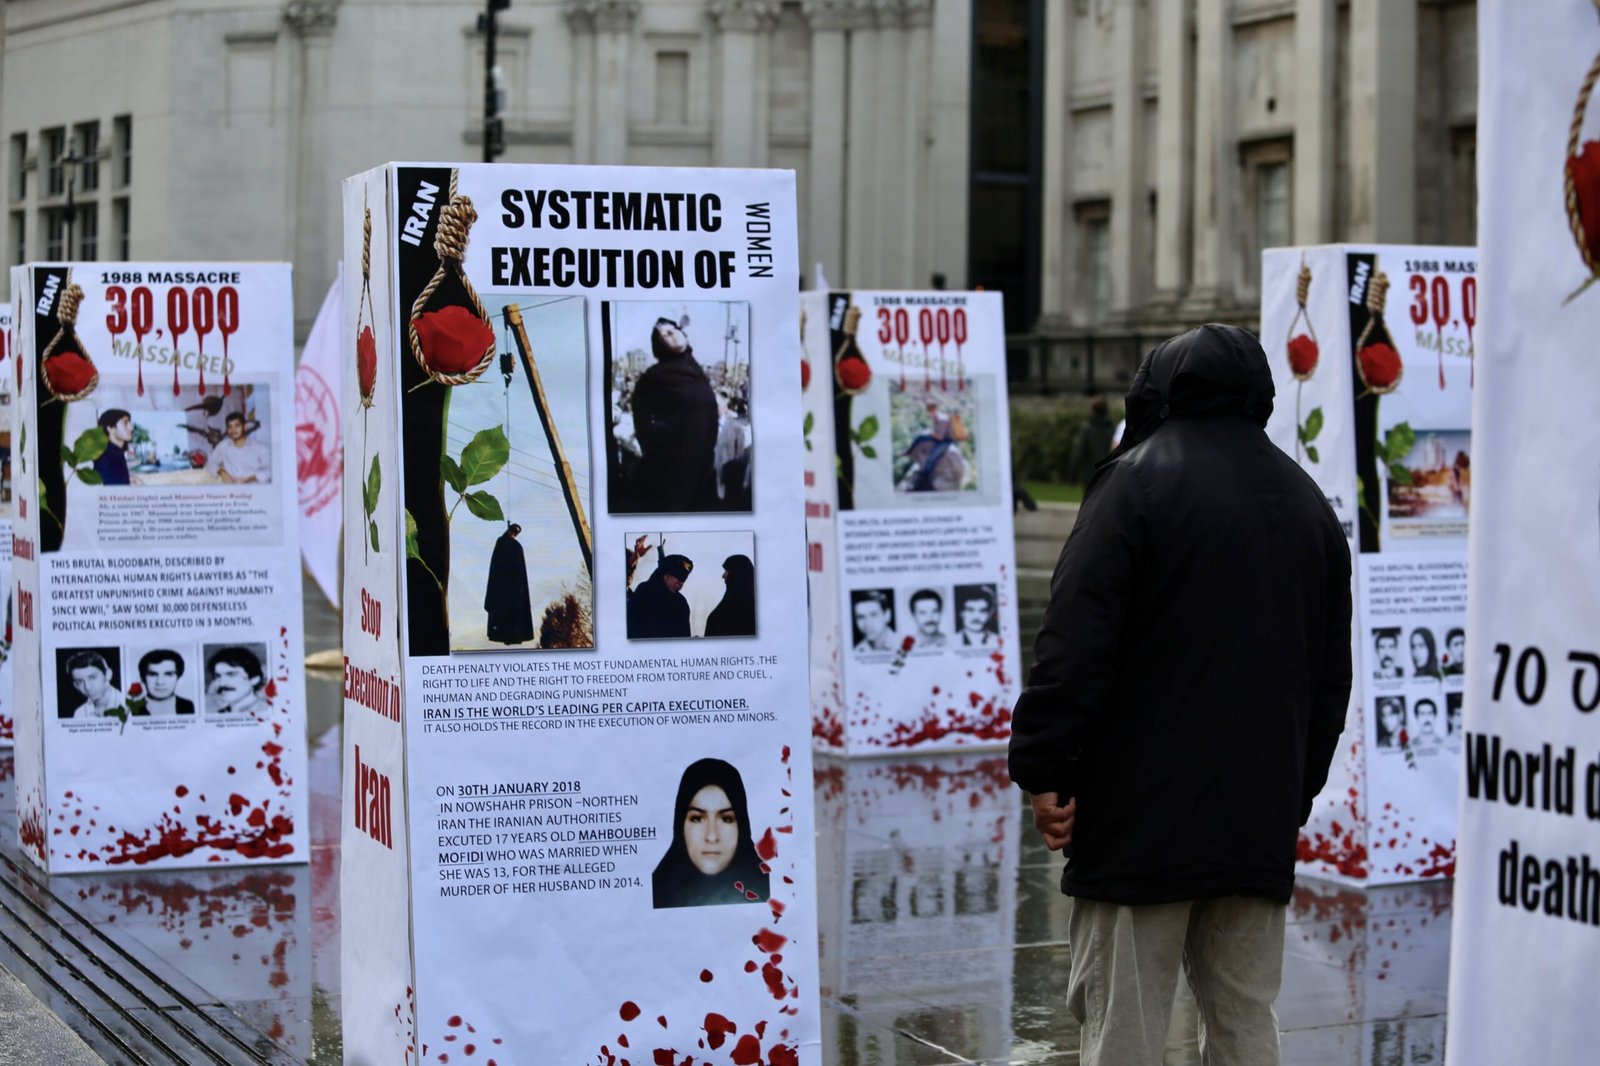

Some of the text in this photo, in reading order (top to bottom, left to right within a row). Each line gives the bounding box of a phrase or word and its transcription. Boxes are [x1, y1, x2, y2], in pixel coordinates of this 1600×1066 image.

[400, 181, 440, 246] IRAN
[501, 189, 722, 232] SYSTEMATIC
[745, 202, 773, 278] WOMEN
[491, 247, 736, 289] EXECUTION OF
[1405, 261, 1439, 272] 1988
[101, 272, 241, 284] 1988 MASSACRE
[1350, 260, 1370, 305] IRAN
[37, 274, 61, 317] IRAN
[105, 286, 239, 340] 30,000
[112, 339, 235, 375] MASSACRED
[51, 559, 70, 569] THIS
[72, 558, 106, 568] BRUTAL
[107, 557, 163, 569] BLOODBATH,
[214, 556, 226, 566] BY
[51, 573, 121, 585] INTERNATIONAL
[123, 572, 158, 583] HUMAN
[160, 572, 192, 582] RIGHTS
[193, 571, 234, 581] LAWYERS
[235, 570, 247, 580] AS
[51, 585, 274, 600] GREATEST UNPUNISHED CRIME AGAINST HUMANITY
[52, 606, 76, 616] SINCE
[112, 604, 132, 614] SAW
[134, 604, 159, 614] SOME
[162, 603, 189, 615] 30,000
[190, 602, 247, 612] DEFENSELESS
[361, 587, 381, 641] Stop
[52, 617, 255, 632] POLITICAL PRISONERS EXECUTED IN 3 MONTHS.
[422, 664, 456, 675] DEATH
[458, 663, 501, 674] PENALTY
[503, 662, 550, 672] VIOLATES
[551, 661, 571, 671] THE
[573, 660, 601, 670] MOST
[604, 658, 678, 670] FUNDAMENTAL
[681, 657, 718, 668] HUMAN
[720, 656, 755, 666] RIGHTS
[344, 656, 400, 723] Execution in
[422, 678, 454, 689] RIGHT
[455, 678, 469, 688] TO
[470, 677, 490, 688] LIFE
[492, 677, 515, 687] AND
[516, 676, 536, 686] THE
[539, 675, 570, 686] RIGHT
[571, 675, 584, 685] TO
[586, 673, 634, 684] FREEDOM
[636, 673, 666, 683] FROM
[667, 671, 710, 682] TORTURE
[712, 671, 735, 681] AND
[423, 688, 628, 703] INHUMAN AND DEGRADING PUNISHMENT
[424, 708, 450, 719] IRAN
[454, 708, 464, 718] IS
[466, 707, 489, 718] THE
[548, 703, 599, 715] LEADING
[602, 702, 623, 713] PER
[626, 701, 666, 712] CAPITA
[669, 698, 750, 711] EXECUTIONER.
[424, 712, 778, 733] IT ALSO HOLDS THE RECORD IN THE EXECUTION OF WOMEN AND MINORS.
[1466, 732, 1575, 817] World
[354, 744, 392, 850] Iran
[436, 781, 581, 796] ON 30TH JANUARY 2018
[440, 802, 453, 813] IN
[455, 799, 526, 813] NOWSHAHR
[528, 797, 573, 810] PRISON
[437, 812, 622, 830] IRAN THE IRANIAN AUTHORITIES
[438, 827, 657, 847] EXCUTED 17 YEARS OLD MAHBOUBEH
[438, 844, 638, 864] MOFIDI WHO WAS MARRIED WHEN
[439, 861, 616, 880] SHE WAS 13, FOR THE ALLEGED
[440, 877, 643, 897] MURDER OF HER HUSBAND IN 2014.
[1499, 840, 1600, 927] death
